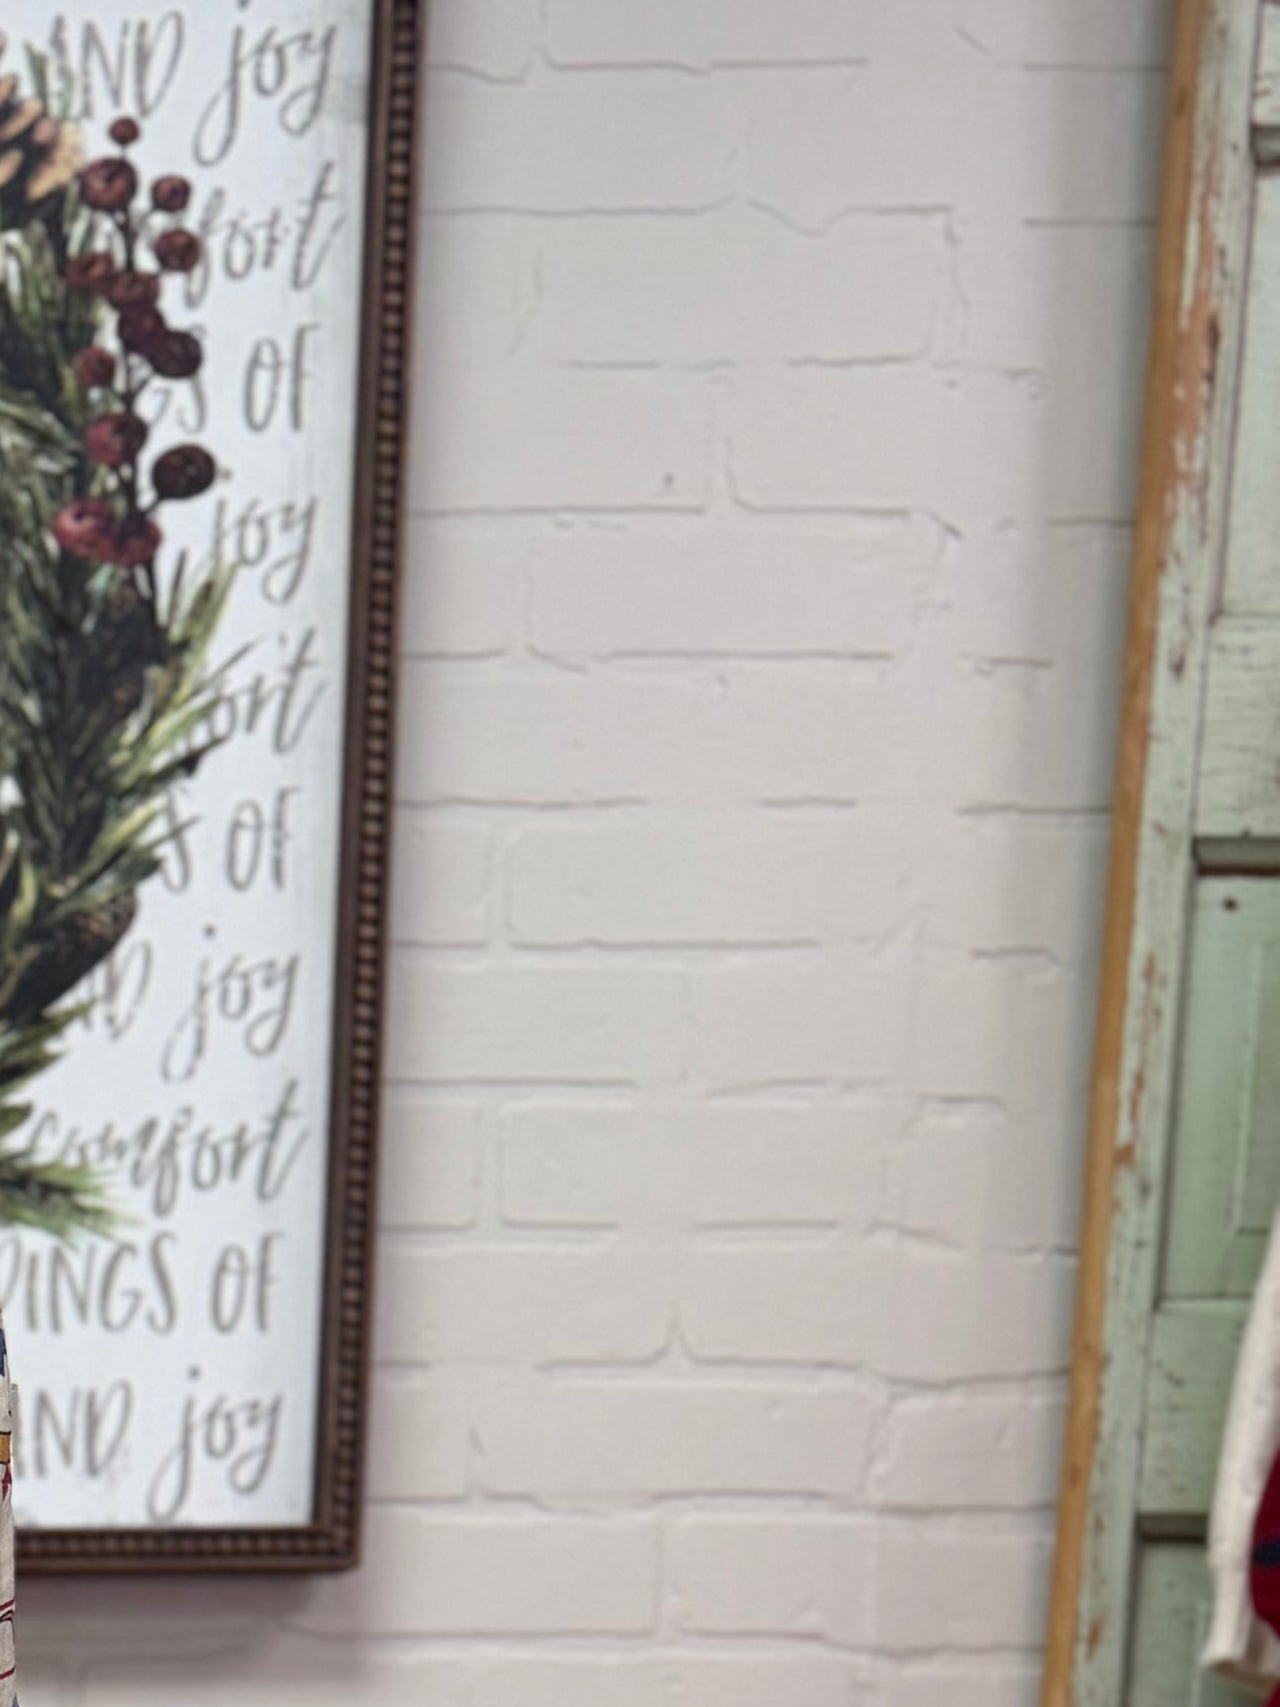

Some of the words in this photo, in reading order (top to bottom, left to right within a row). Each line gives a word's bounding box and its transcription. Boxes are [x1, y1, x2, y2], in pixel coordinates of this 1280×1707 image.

[193, 0, 337, 167] joy
[245, 322, 321, 432] OF
[227, 787, 301, 892] OF
[161, 923, 302, 1084] joy
[212, 1231, 286, 1335] OF
[148, 1364, 283, 1524] joy
